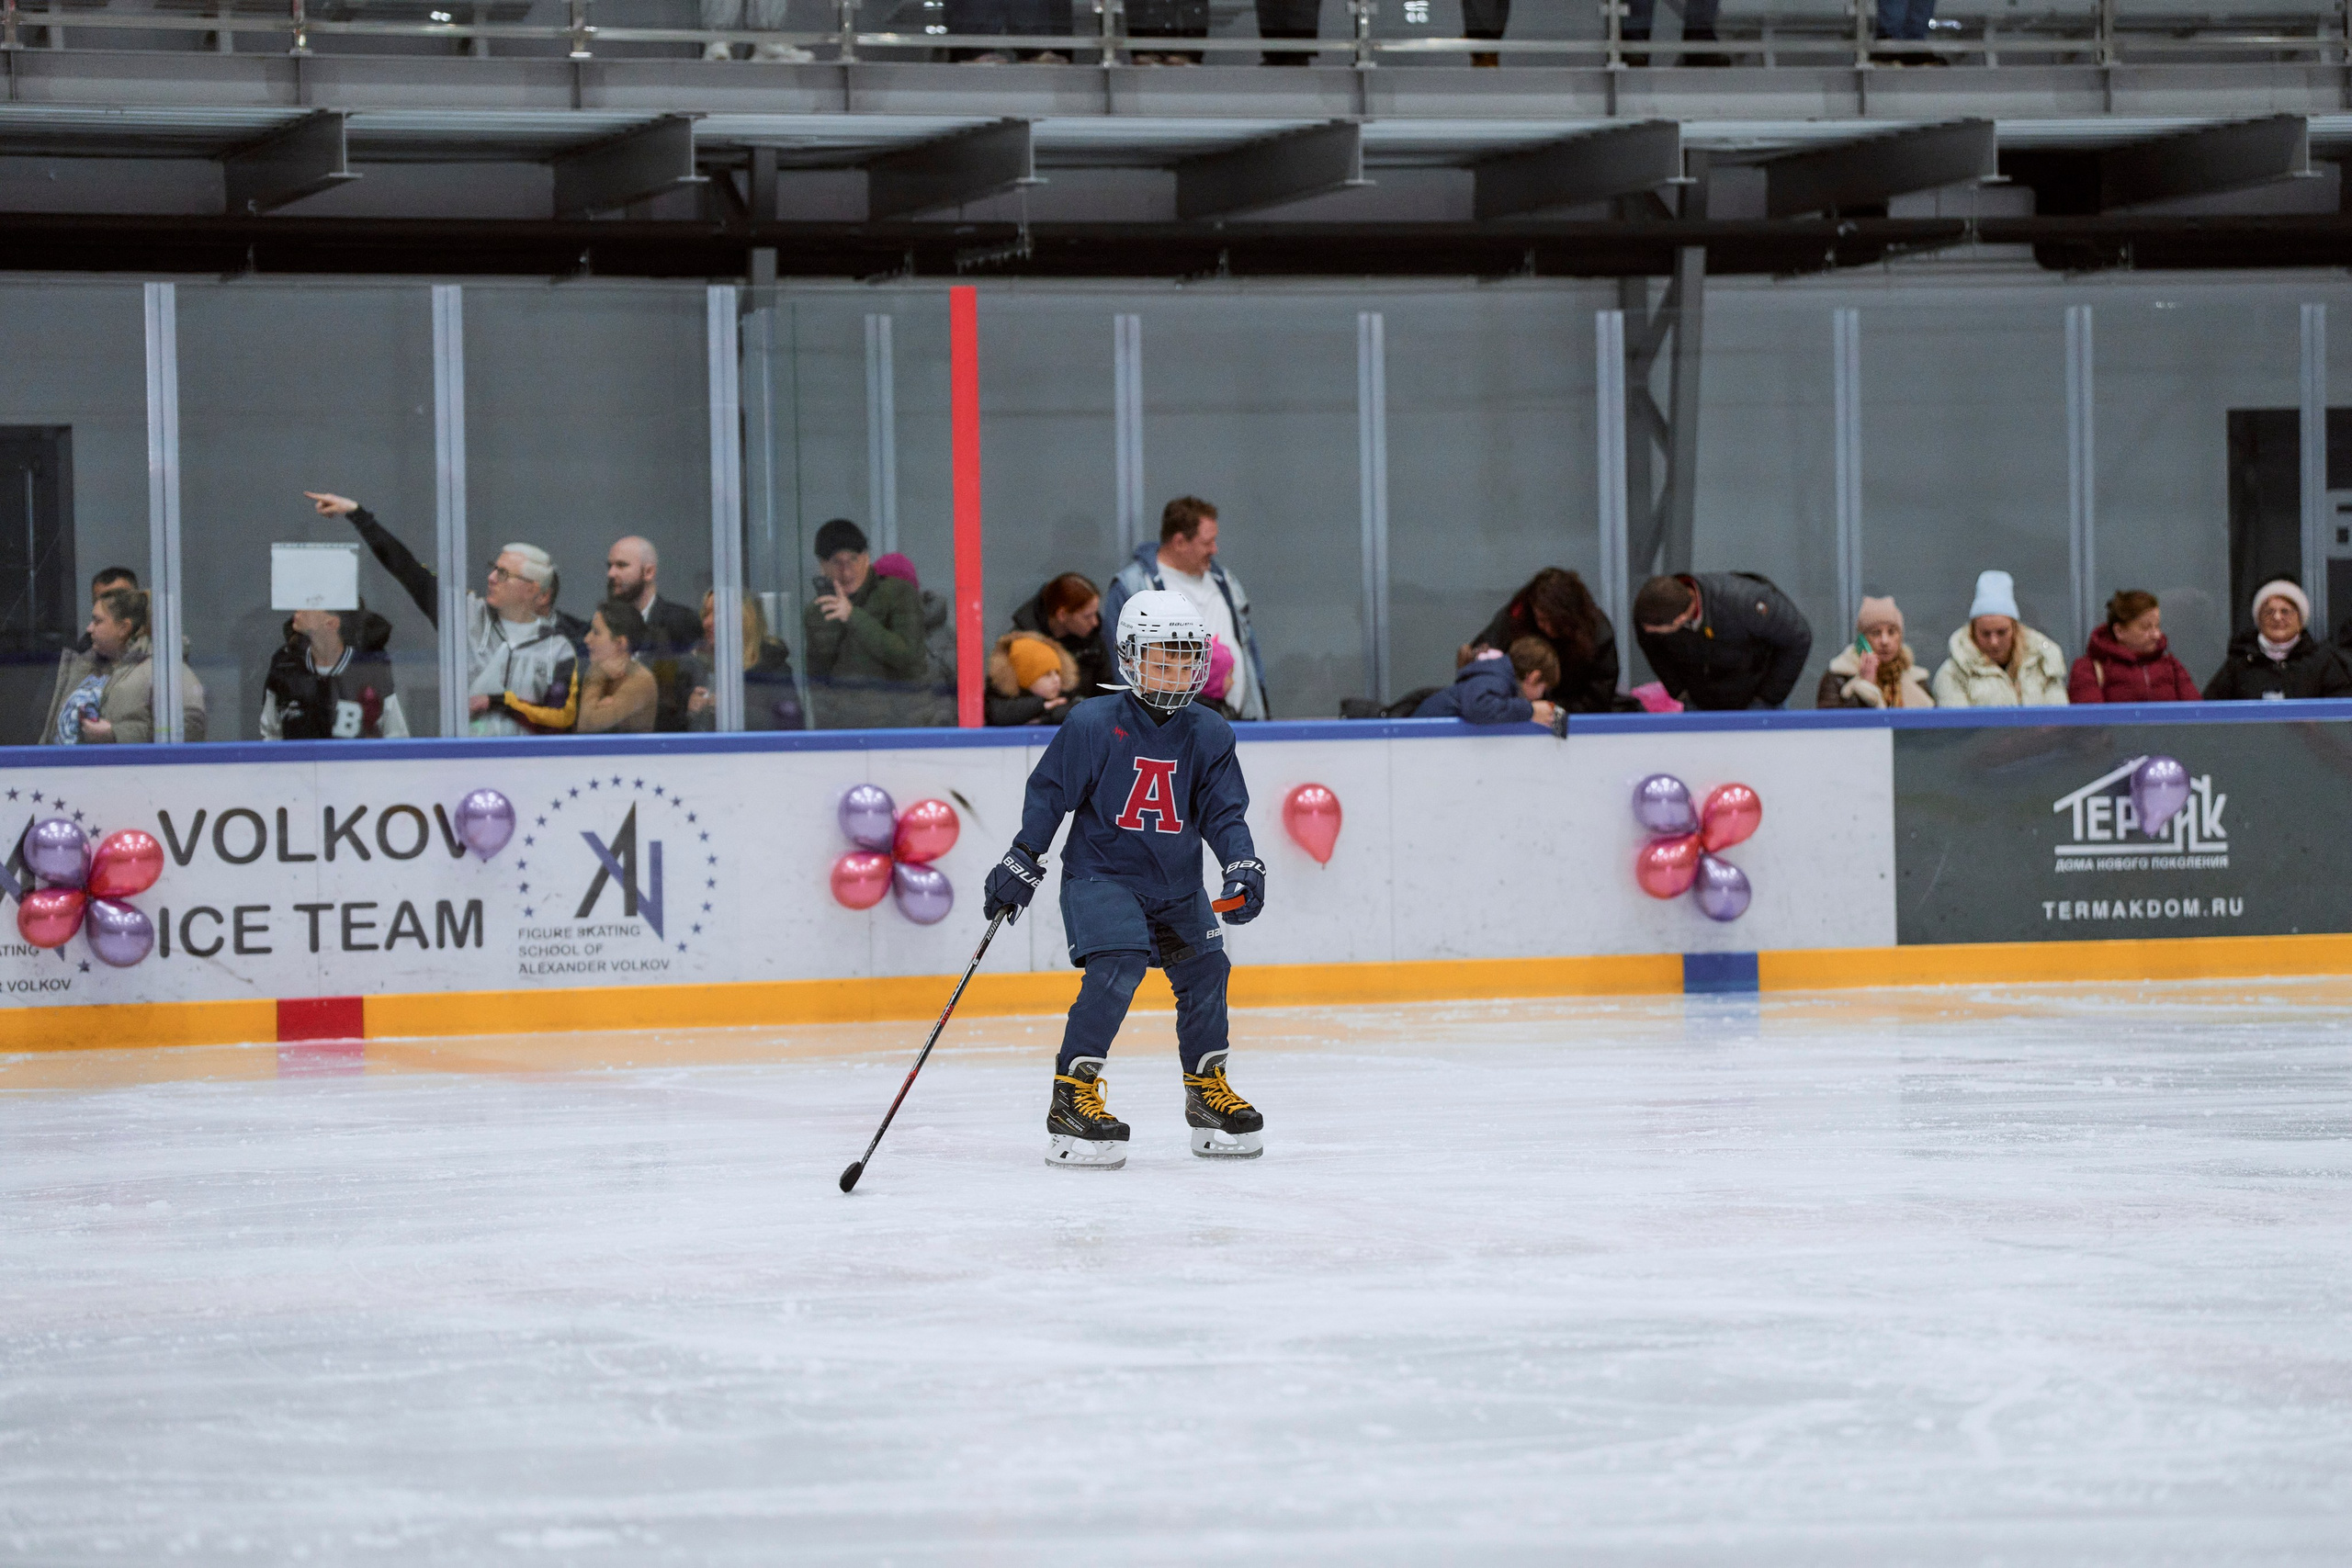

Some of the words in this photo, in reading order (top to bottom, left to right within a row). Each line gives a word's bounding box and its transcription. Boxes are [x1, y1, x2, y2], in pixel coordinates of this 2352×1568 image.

[1115, 756, 1184, 834] A
[1002, 856, 1041, 888] BAUE
[2054, 857, 2096, 873] ДОМА
[2096, 856, 2150, 872] НОВОГО
[2151, 854, 2229, 870] ПОКОЛЕНИЯ
[2041, 897, 2245, 920] TERMAKDOM.RU
[159, 904, 273, 958] ICE
[293, 898, 484, 953] TEAM
[518, 927, 573, 940] FIGURE
[577, 924, 641, 937] SKATING
[0, 944, 39, 957] TING
[518, 944, 581, 957] SCHOOL
[584, 942, 604, 955] OF
[518, 962, 607, 975] ALEXANDER
[611, 959, 671, 972] VOLKOV
[7, 978, 72, 992] VOLKOV
